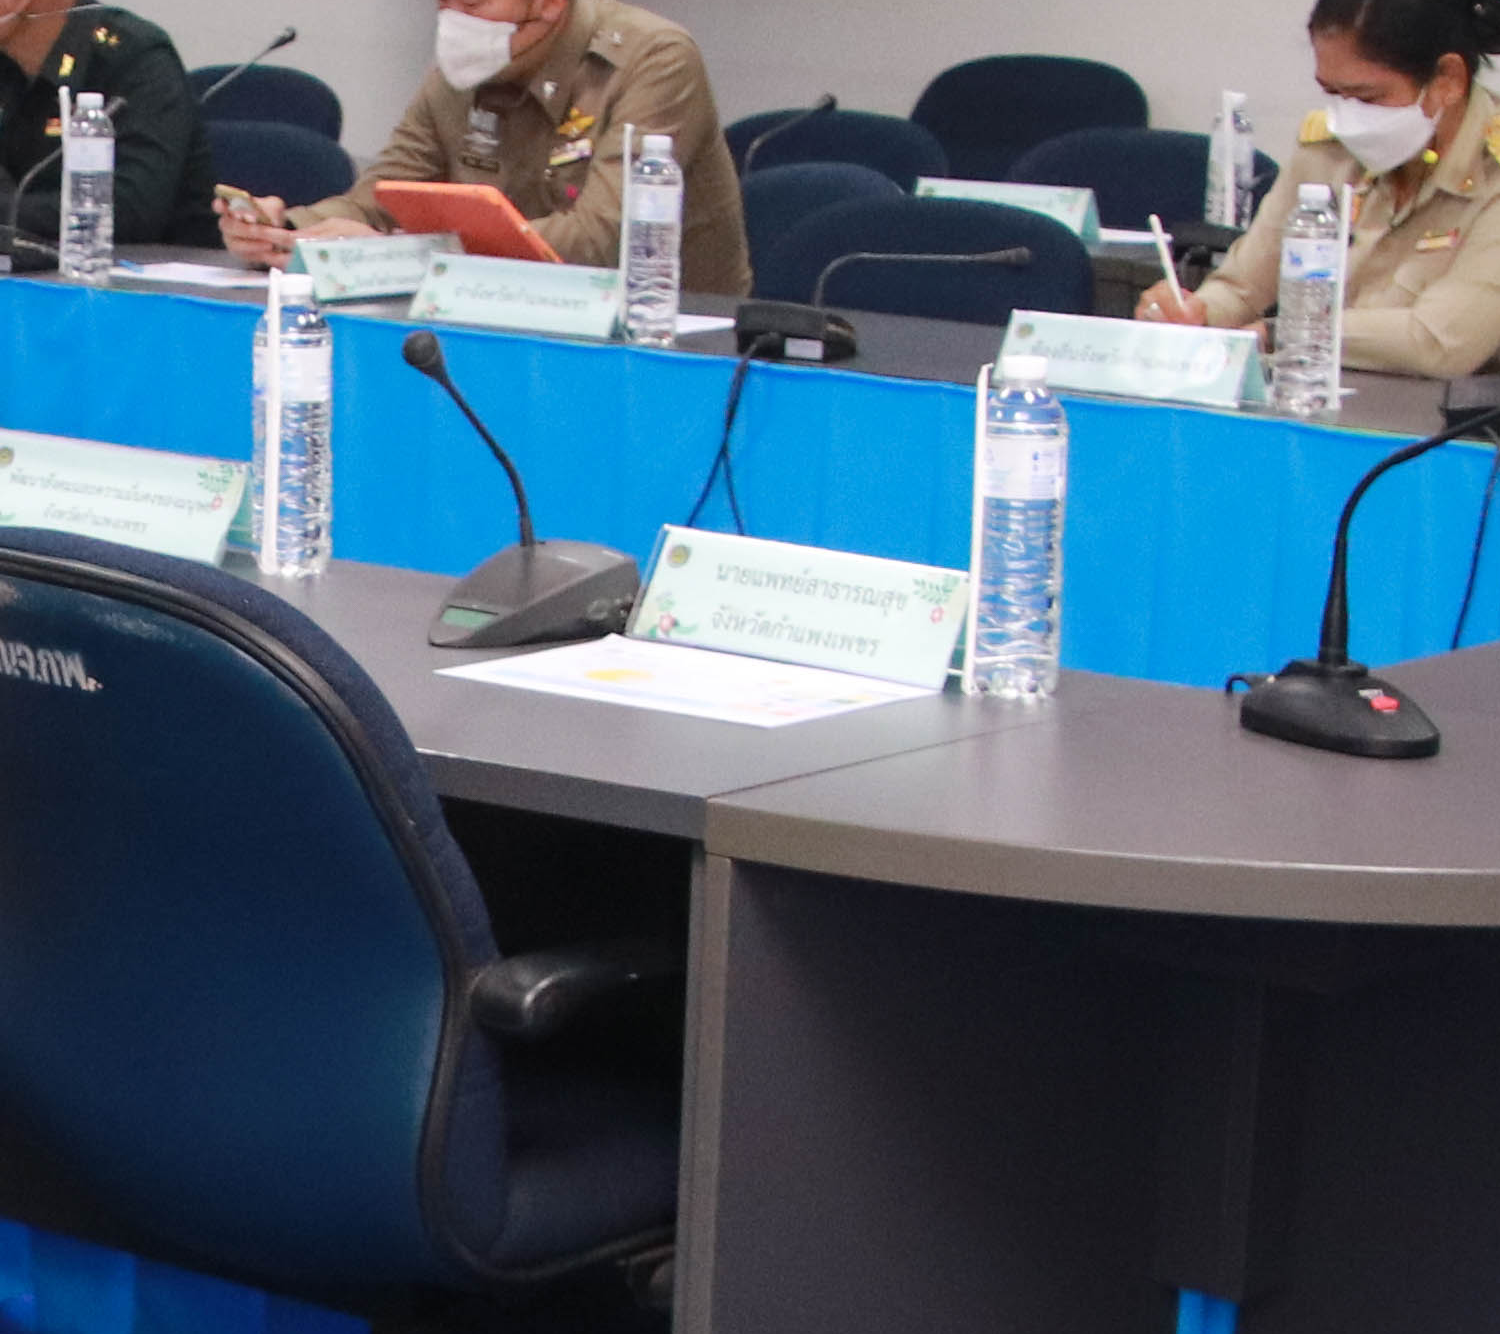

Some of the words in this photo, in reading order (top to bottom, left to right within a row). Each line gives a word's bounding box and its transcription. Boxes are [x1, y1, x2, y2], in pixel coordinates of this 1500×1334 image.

[716, 562, 908, 616] นายแพทย์สาธารณสุข
[711, 604, 880, 657] จังหวัดกำแพงเพชร
